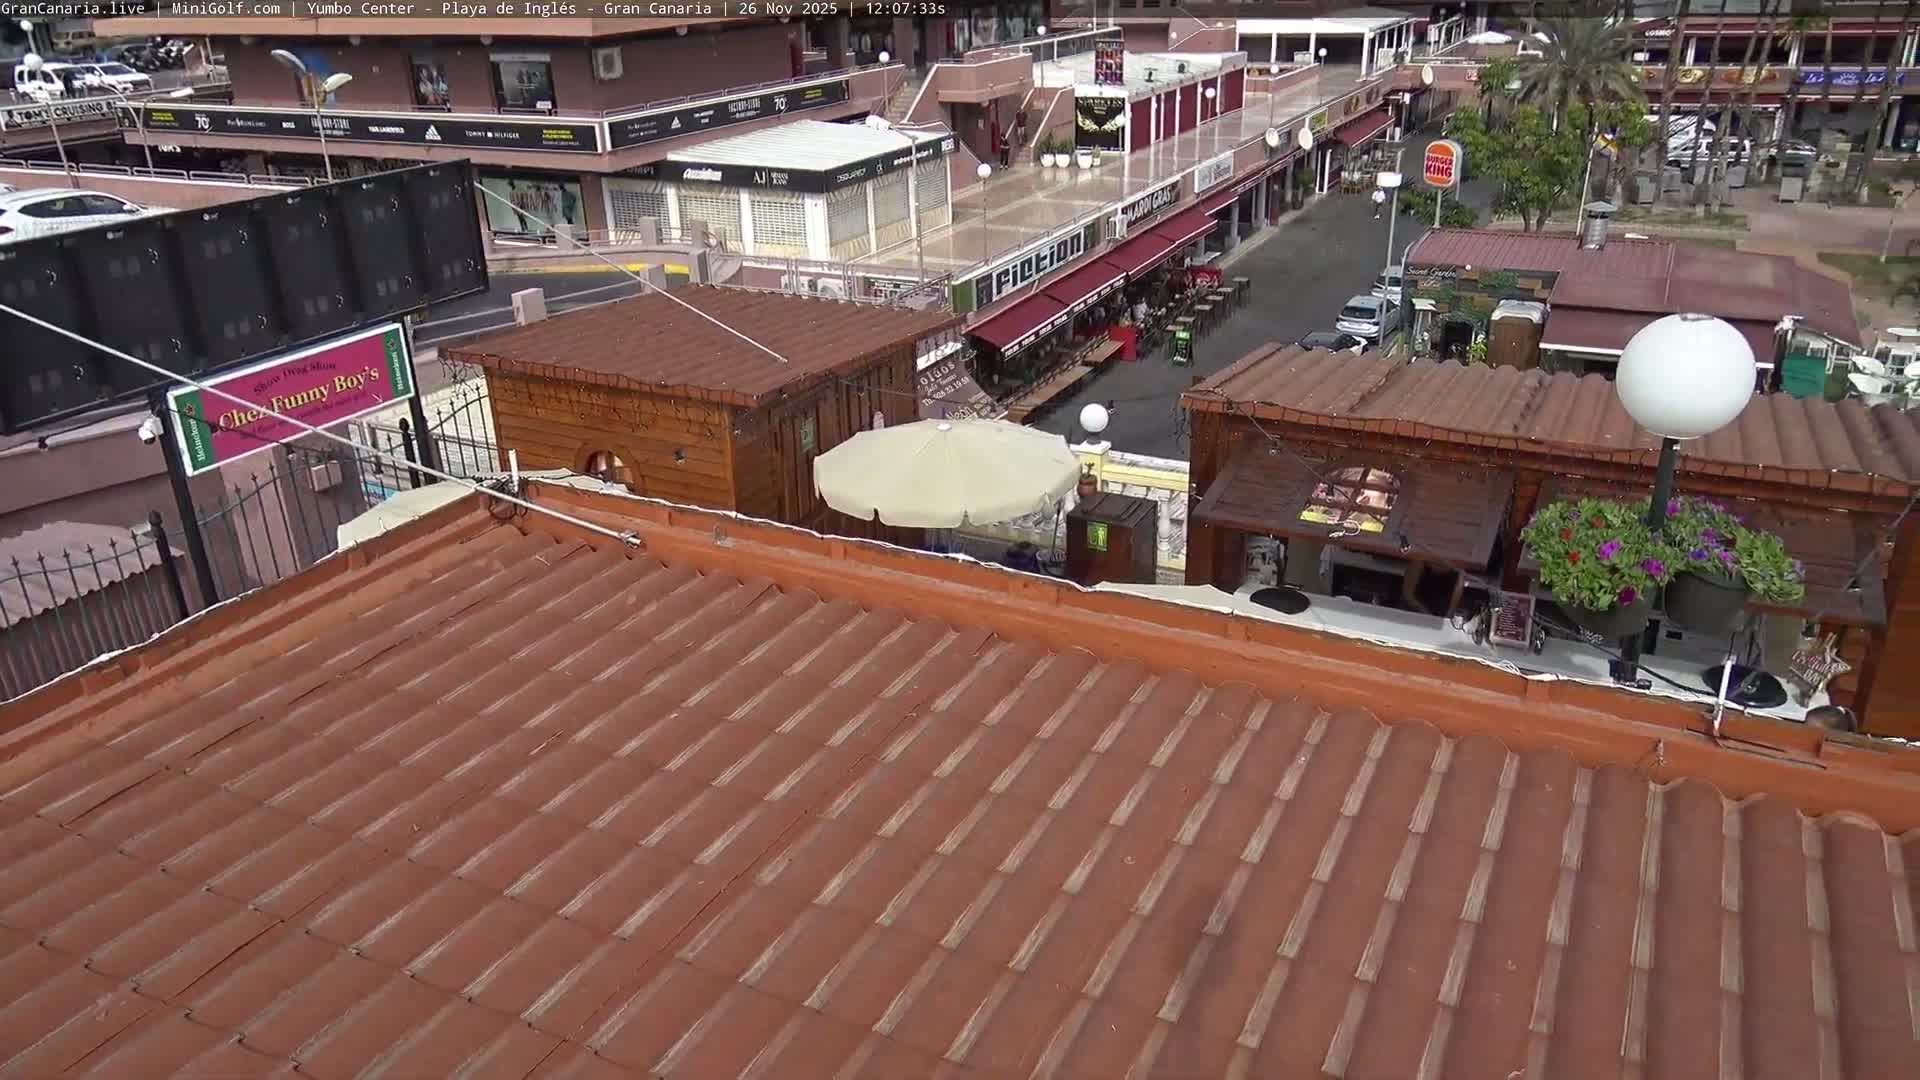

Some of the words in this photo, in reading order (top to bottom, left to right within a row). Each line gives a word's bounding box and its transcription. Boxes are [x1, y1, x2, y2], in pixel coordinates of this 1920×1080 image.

[54, 102, 104, 117] CRUISING
[1426, 154, 1454, 166] BURGER
[1425, 163, 1452, 178] KING
[1127, 196, 1152, 223] MARDI
[1152, 186, 1172, 212] GRAS
[271, 384, 330, 414] Funny
[334, 366, 380, 393] Boy's
